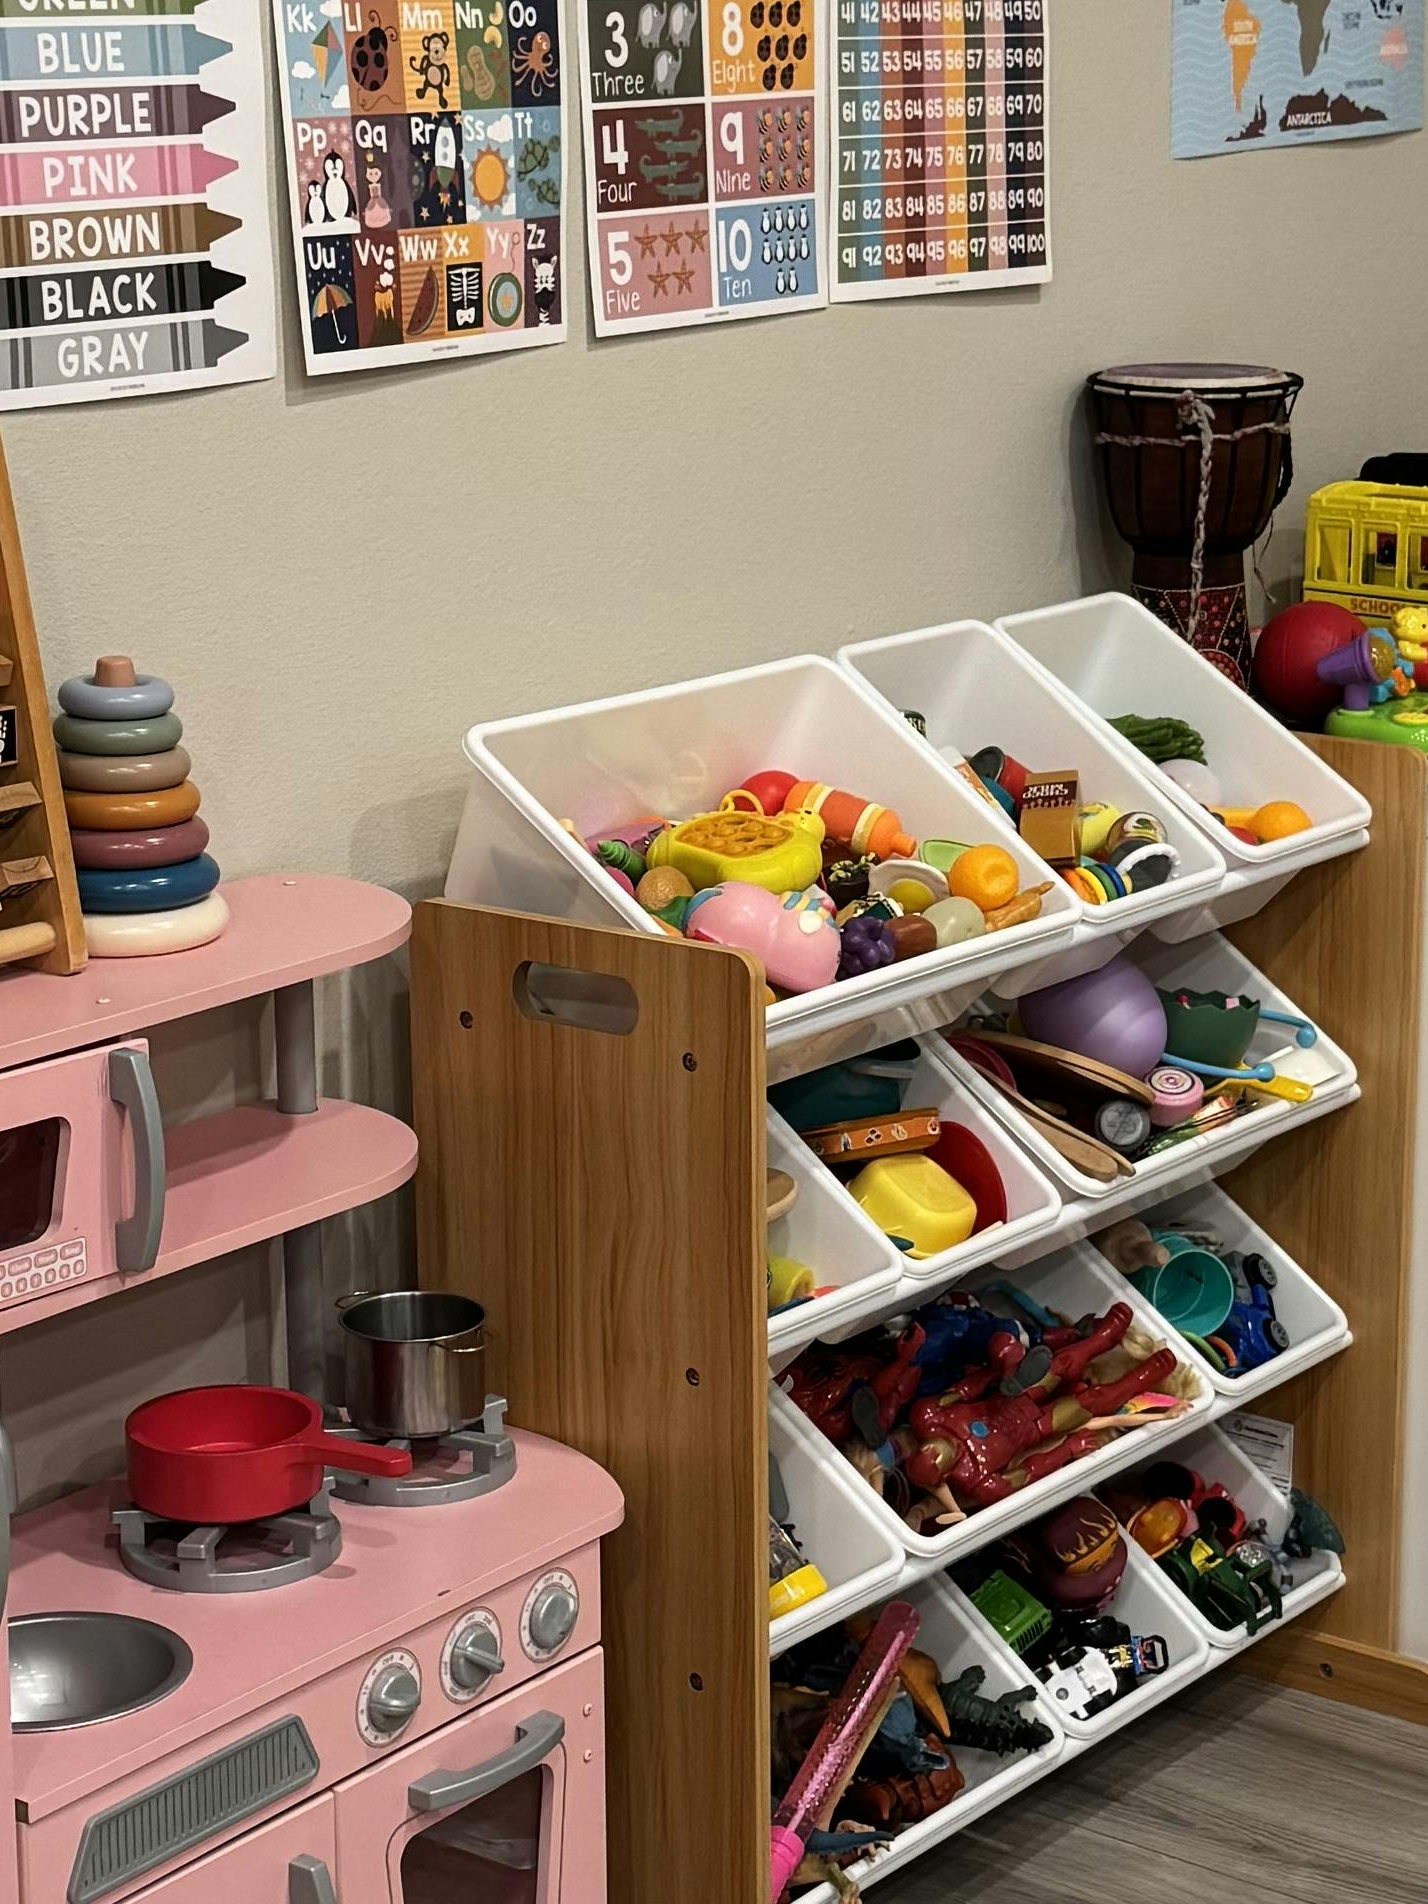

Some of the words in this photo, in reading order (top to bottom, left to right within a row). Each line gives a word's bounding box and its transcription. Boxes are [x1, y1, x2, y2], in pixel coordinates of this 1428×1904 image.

[37, 33, 125, 75] BLUE
[592, 72, 645, 96] Three
[42, 156, 137, 197] PINK
[597, 180, 637, 204] Four
[29, 212, 160, 259] BROWN
[718, 219, 751, 273] 10
[41, 273, 157, 322] BLACK
[56, 332, 149, 377] GRAY
